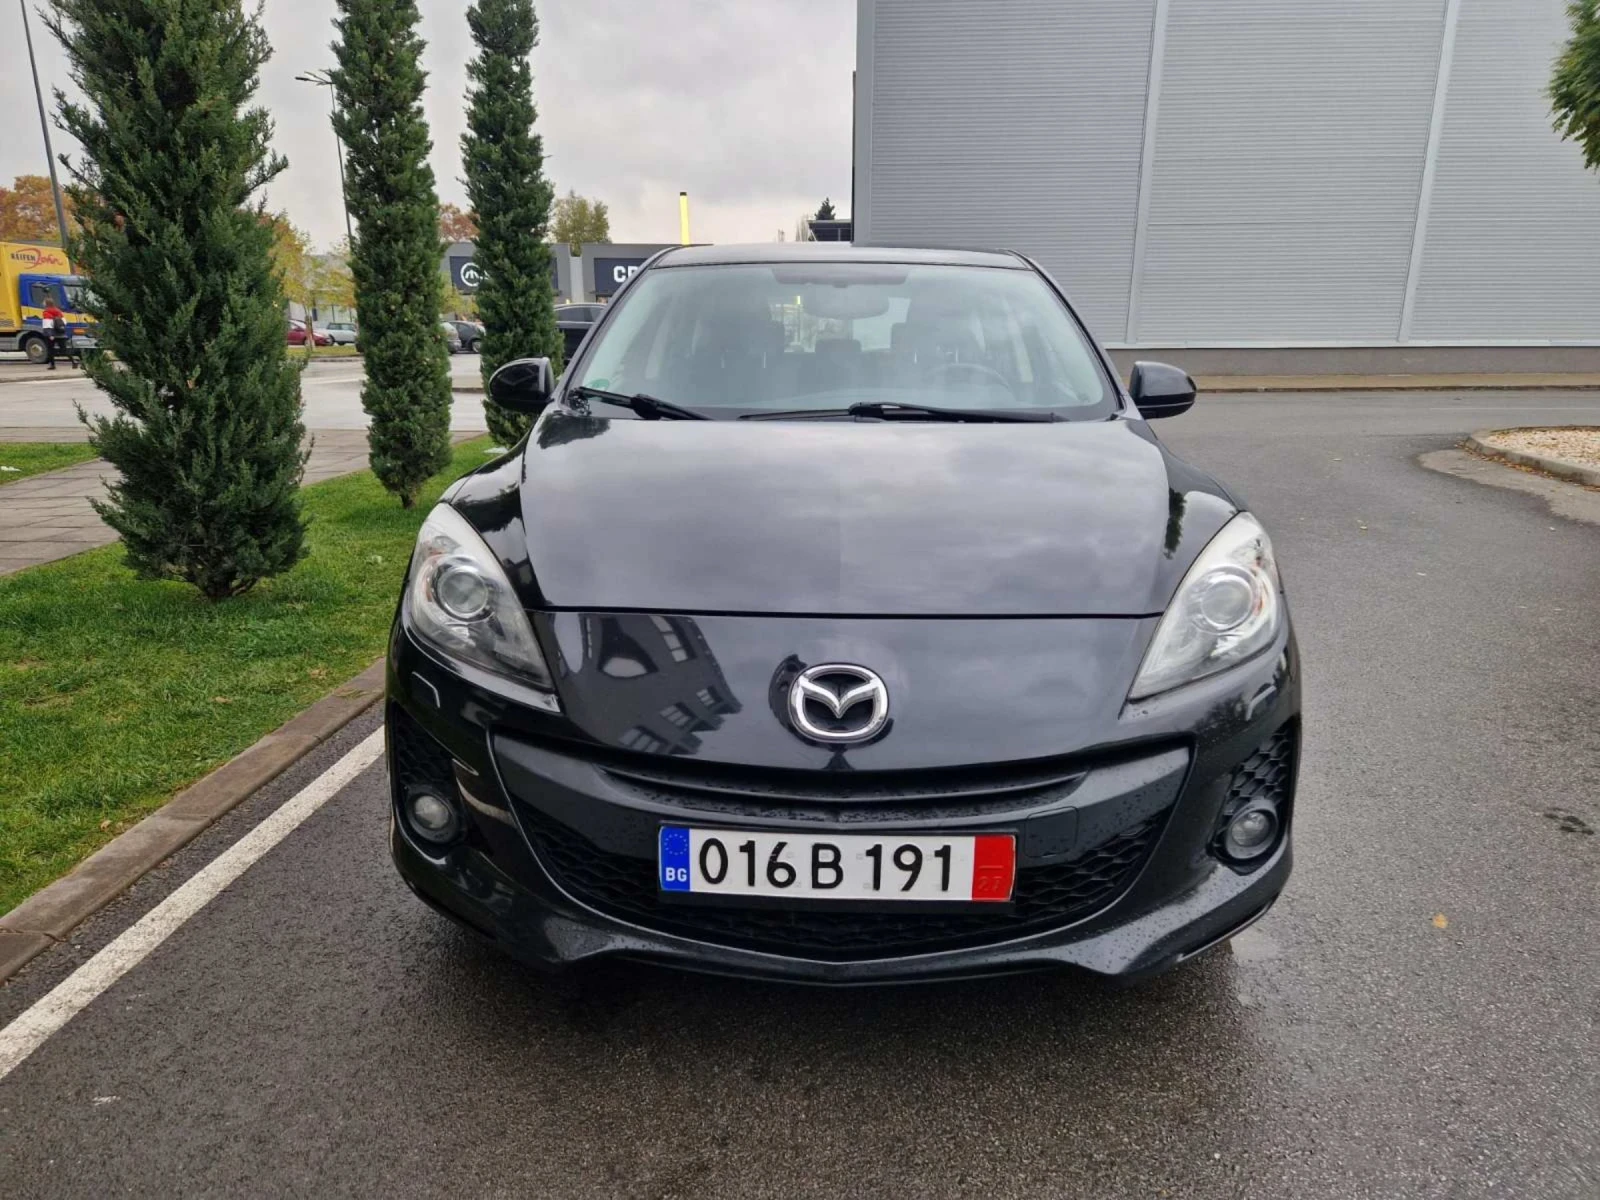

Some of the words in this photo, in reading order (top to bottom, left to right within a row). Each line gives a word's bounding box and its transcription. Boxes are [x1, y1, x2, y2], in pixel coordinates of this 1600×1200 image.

[665, 867, 688, 882] BG
[699, 837, 797, 888] 016
[865, 844, 952, 892] 191
